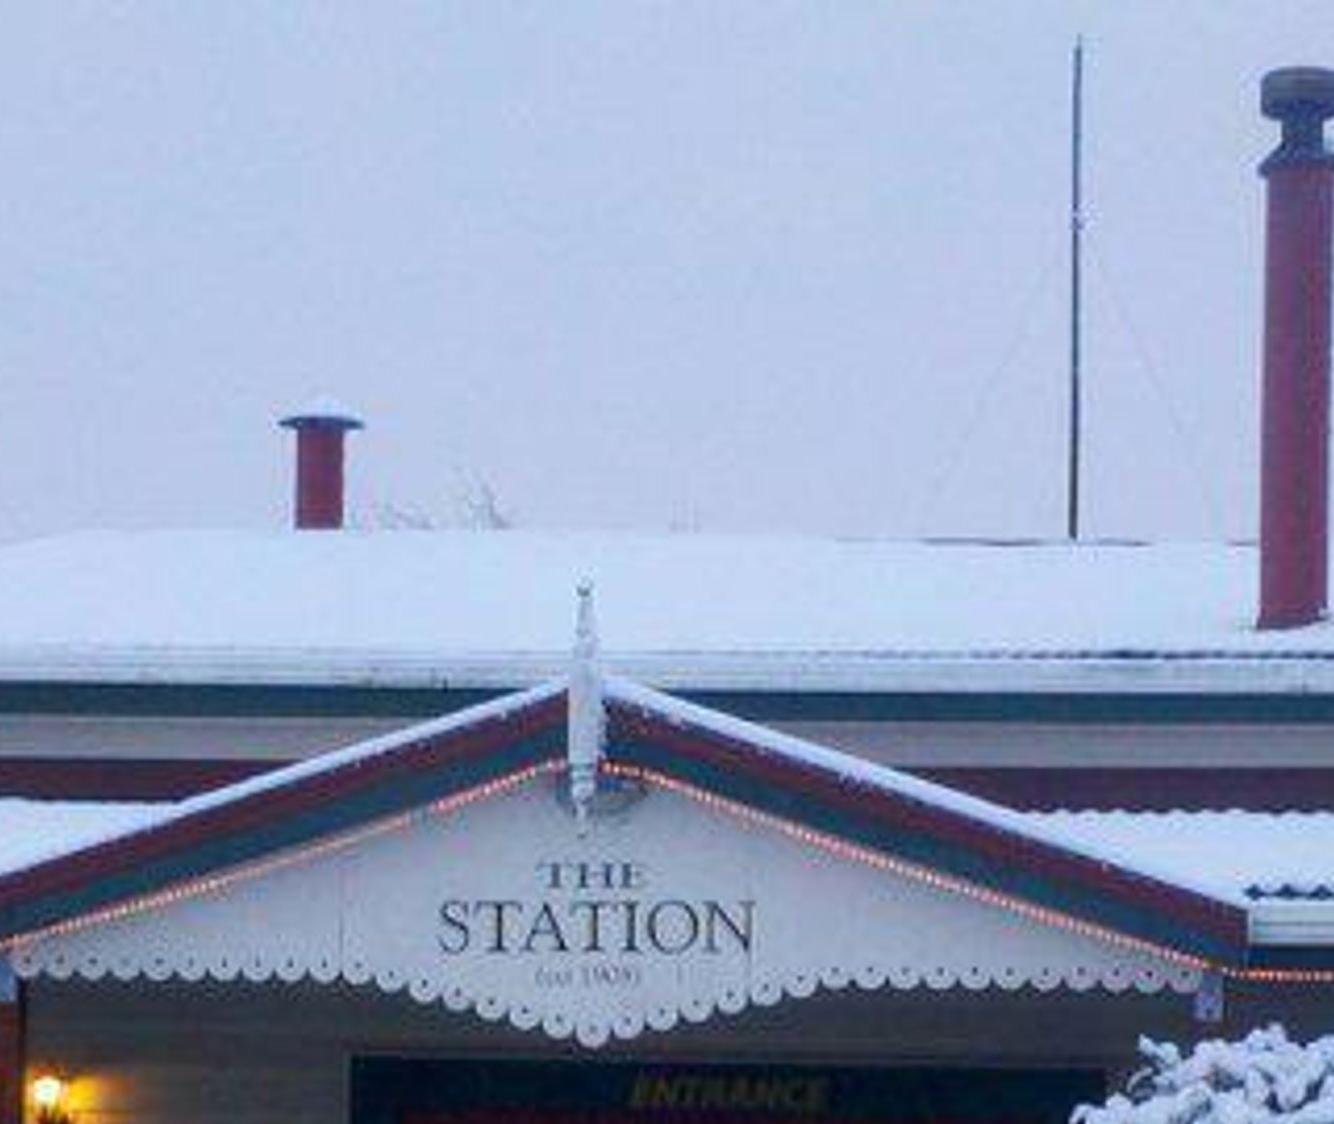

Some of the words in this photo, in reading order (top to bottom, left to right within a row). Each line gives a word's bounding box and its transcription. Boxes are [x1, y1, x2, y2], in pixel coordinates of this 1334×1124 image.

[542, 861, 646, 889] THE
[439, 900, 756, 954] STATION
[630, 1074, 832, 1108] ENTRANCE
